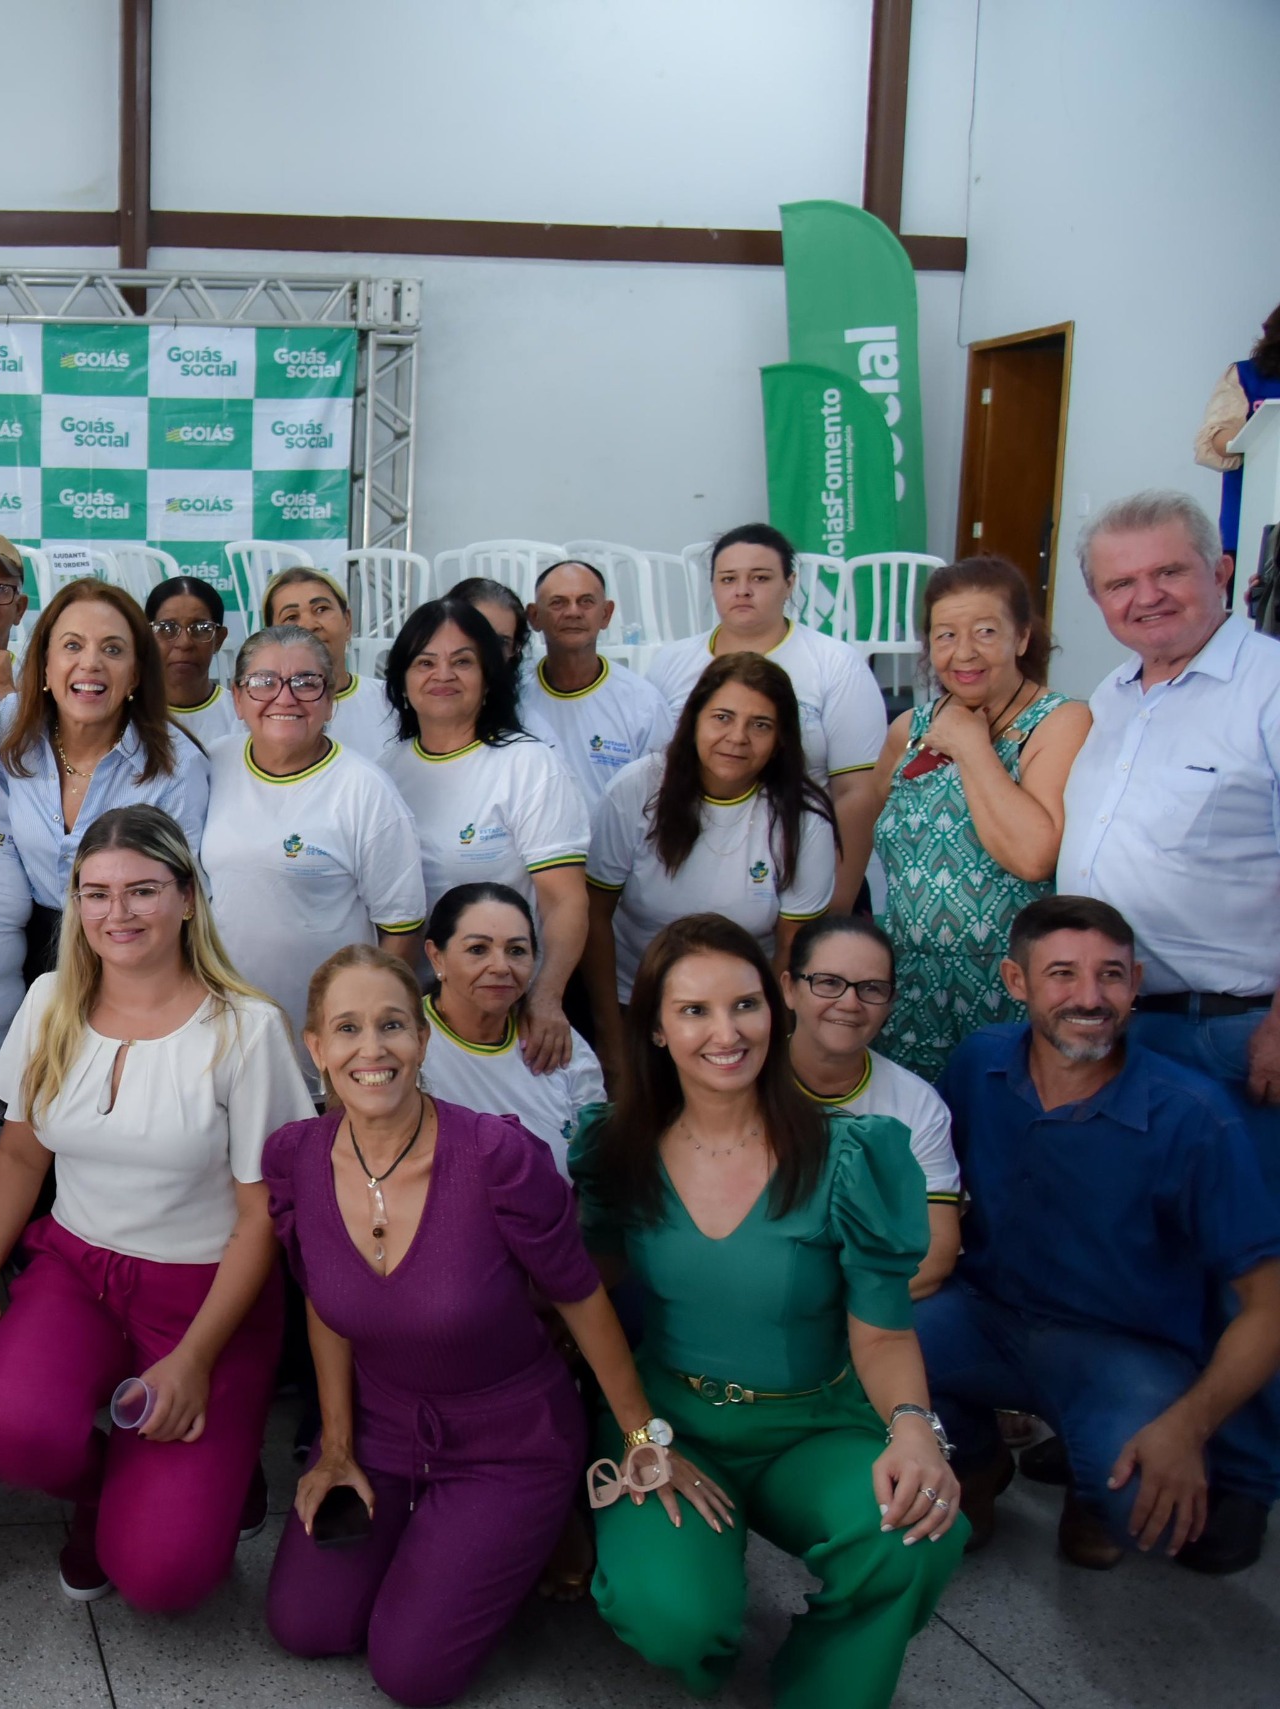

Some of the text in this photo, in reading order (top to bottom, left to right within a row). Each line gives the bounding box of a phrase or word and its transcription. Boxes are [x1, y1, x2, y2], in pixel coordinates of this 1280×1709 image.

[74, 350, 130, 367] GOIÁS
[168, 346, 222, 362] Goiás
[274, 348, 327, 364] Goiás
[180, 360, 236, 376] social
[286, 360, 342, 378] social
[60, 416, 115, 433] Goiás
[179, 424, 235, 442] GOIÁS
[271, 419, 323, 436] Goiás
[74, 432, 130, 448] social
[285, 433, 334, 449] social
[59, 488, 116, 506] Goiás
[179, 496, 234, 512] GOIÁS
[270, 490, 318, 507] Goiás
[72, 502, 130, 520] social
[282, 502, 332, 520] social
[178, 562, 219, 578] oiás
